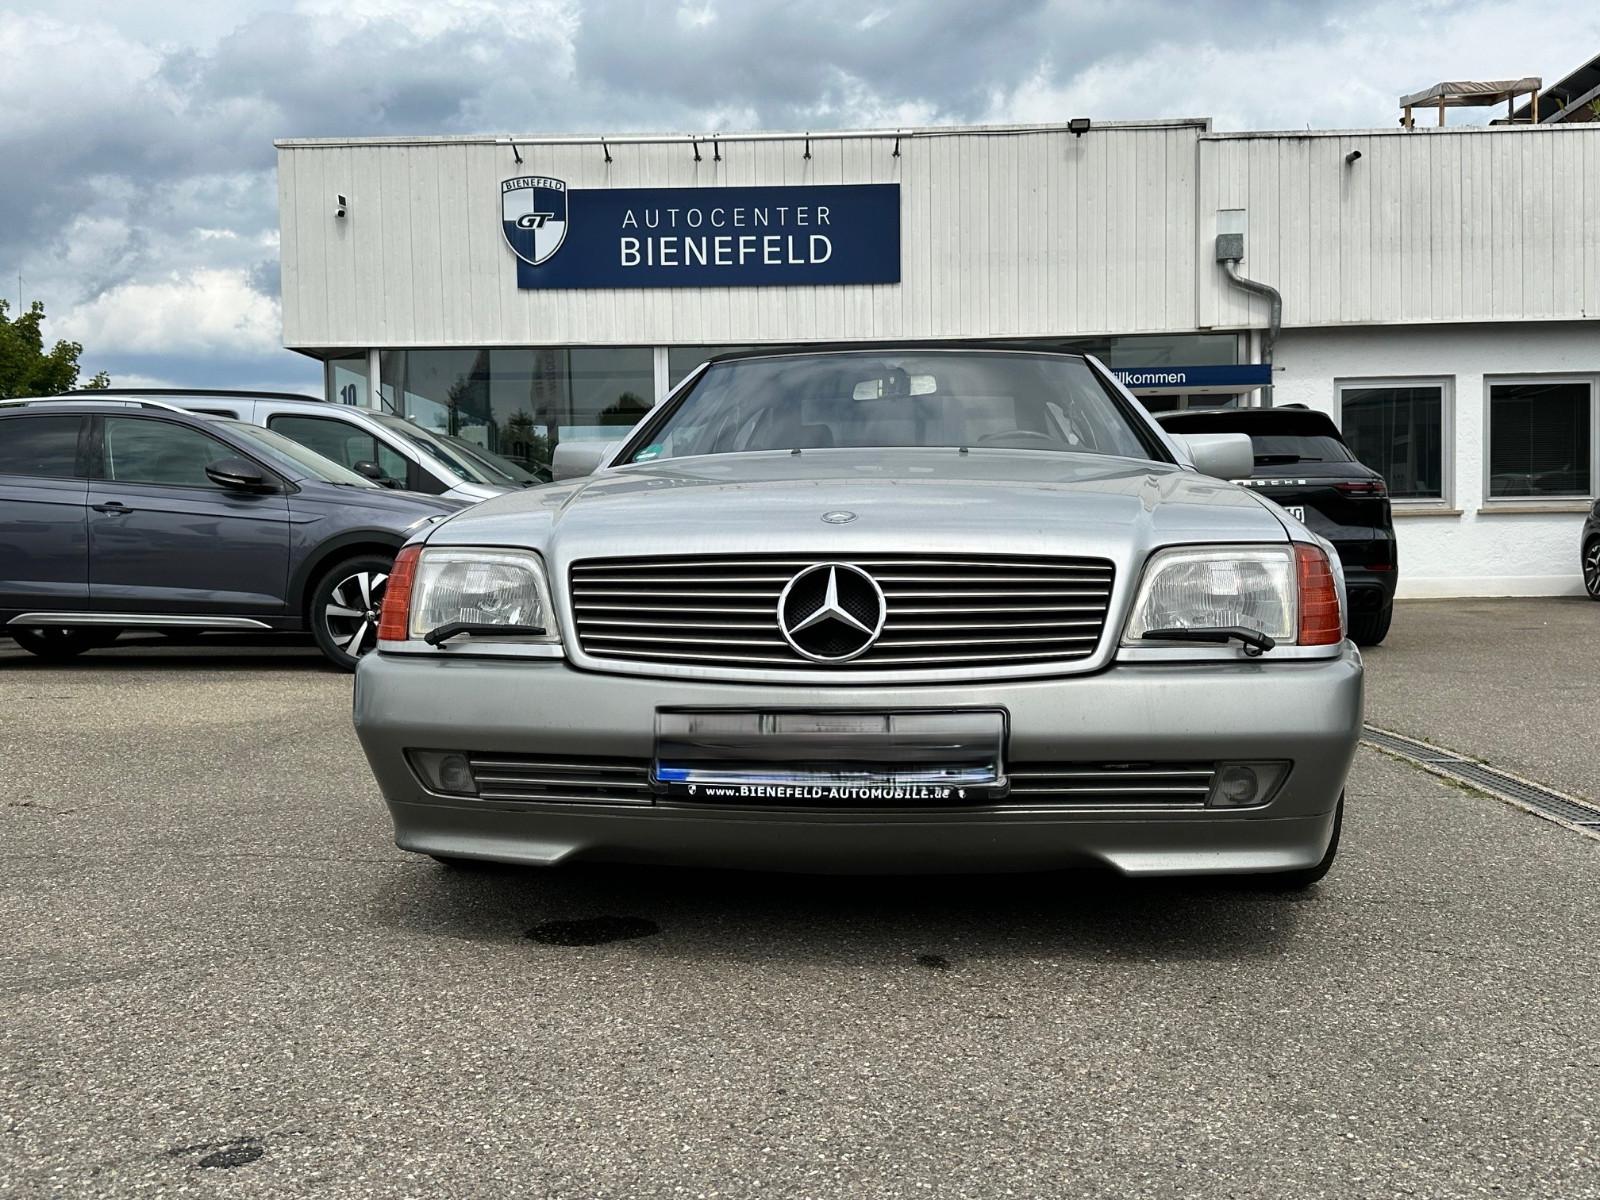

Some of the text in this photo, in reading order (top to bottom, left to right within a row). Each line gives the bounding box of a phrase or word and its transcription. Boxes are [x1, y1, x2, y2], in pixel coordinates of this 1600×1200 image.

[505, 178, 562, 190] BIENEFELD
[516, 212, 555, 229] GT
[622, 206, 831, 229] AUTOCENTER
[620, 234, 833, 267] BIENEFELD
[1111, 371, 1186, 385] illkommen
